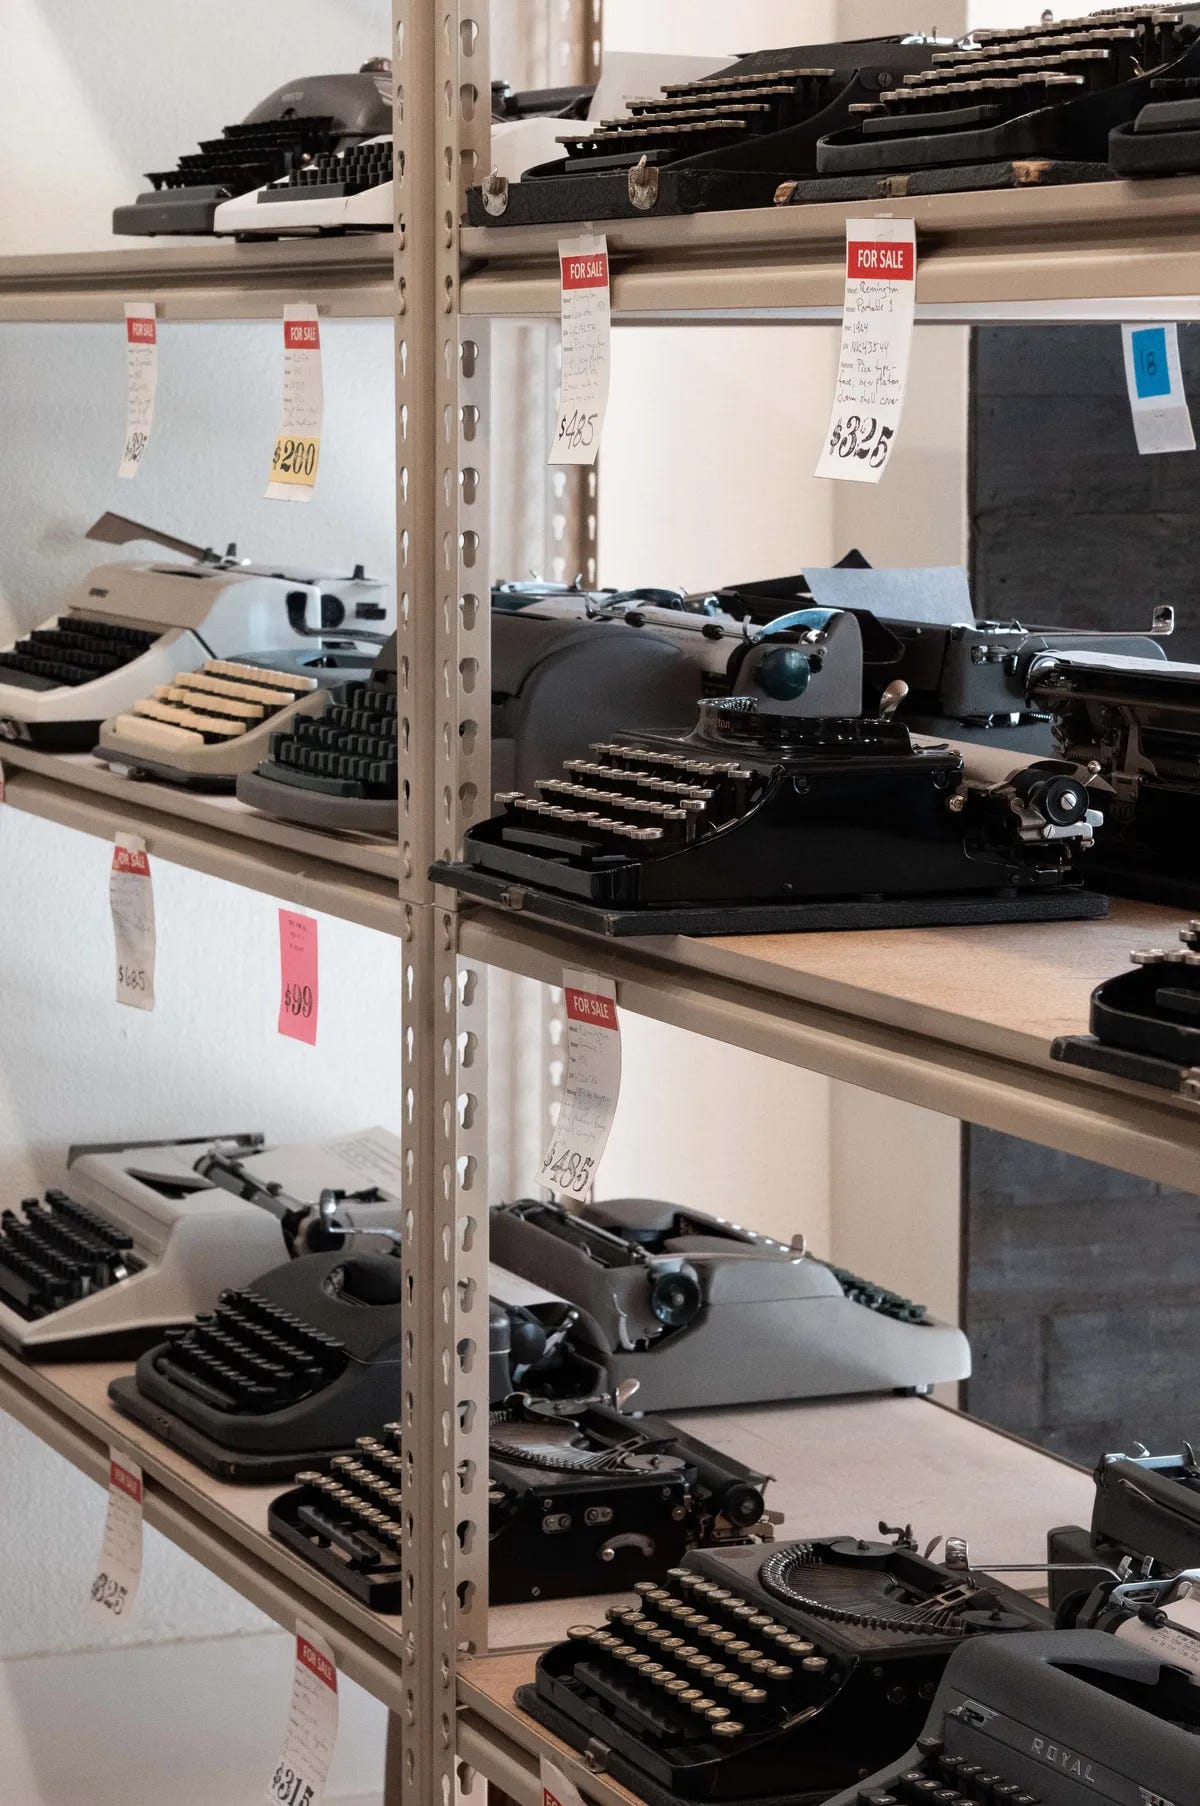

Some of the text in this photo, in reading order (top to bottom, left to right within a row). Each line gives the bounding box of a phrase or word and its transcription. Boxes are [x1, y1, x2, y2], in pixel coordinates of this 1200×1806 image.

[570, 261, 603, 280] FOR SALE
[857, 249, 904, 269] FOR SALE
[859, 281, 900, 299] Remington
[132, 322, 143, 337] FOR
[290, 326, 317, 341] FOR SALE
[559, 409, 598, 450] $485
[829, 415, 894, 469] $325
[272, 440, 316, 476] $200
[117, 852, 146, 870] FOR SALE
[285, 983, 313, 1018] $99
[573, 996, 610, 1020] FOR SALE
[542, 1140, 596, 1192] $485
[303, 1644, 333, 1681] FOR SALE
[1031, 1738, 1095, 1783] ROYAL
